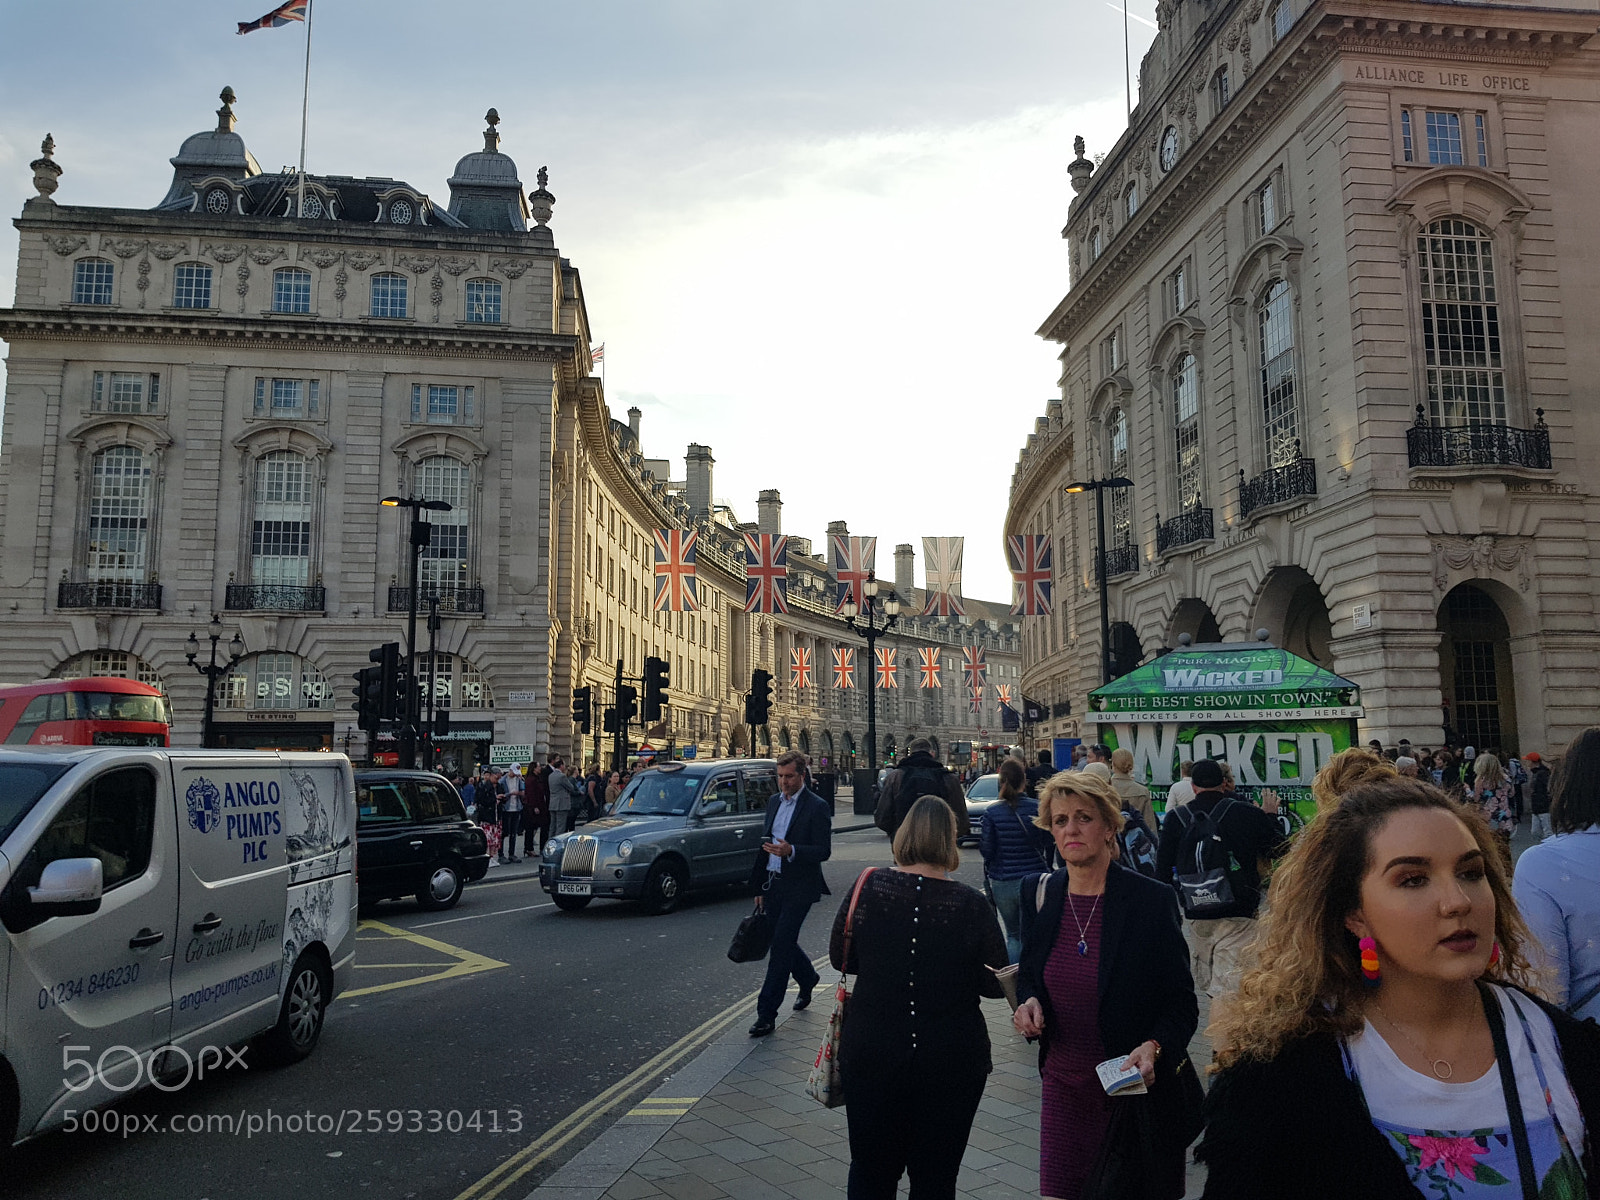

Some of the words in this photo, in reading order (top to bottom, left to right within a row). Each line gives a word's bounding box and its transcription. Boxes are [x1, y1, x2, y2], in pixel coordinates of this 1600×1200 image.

[1355, 65, 1425, 84] ALLIANCE
[1438, 72, 1469, 87] LIFE
[1482, 75, 1530, 91] OFFICE
[1408, 479, 1456, 490] COUNTY
[1506, 481, 1532, 492] FIRE
[1540, 482, 1578, 493] OFFICE
[1152, 696, 1189, 708] BEST
[1194, 694, 1243, 707] SHOW
[1247, 694, 1265, 706] IN
[1224, 711, 1246, 719] ALL
[1258, 710, 1302, 718] SHOWS
[1314, 708, 1346, 716] HERE
[224, 781, 280, 807] ANGLO
[226, 811, 281, 840] PUMPS
[243, 840, 267, 863] PLC
[185, 938, 203, 963] Go
[206, 928, 233, 957] with
[236, 924, 253, 949] the
[251, 919, 279, 953] flow
[39, 977, 84, 1009] 01234
[88, 963, 139, 994] 846230
[179, 962, 277, 1011] anglo-pumps.co.uk
